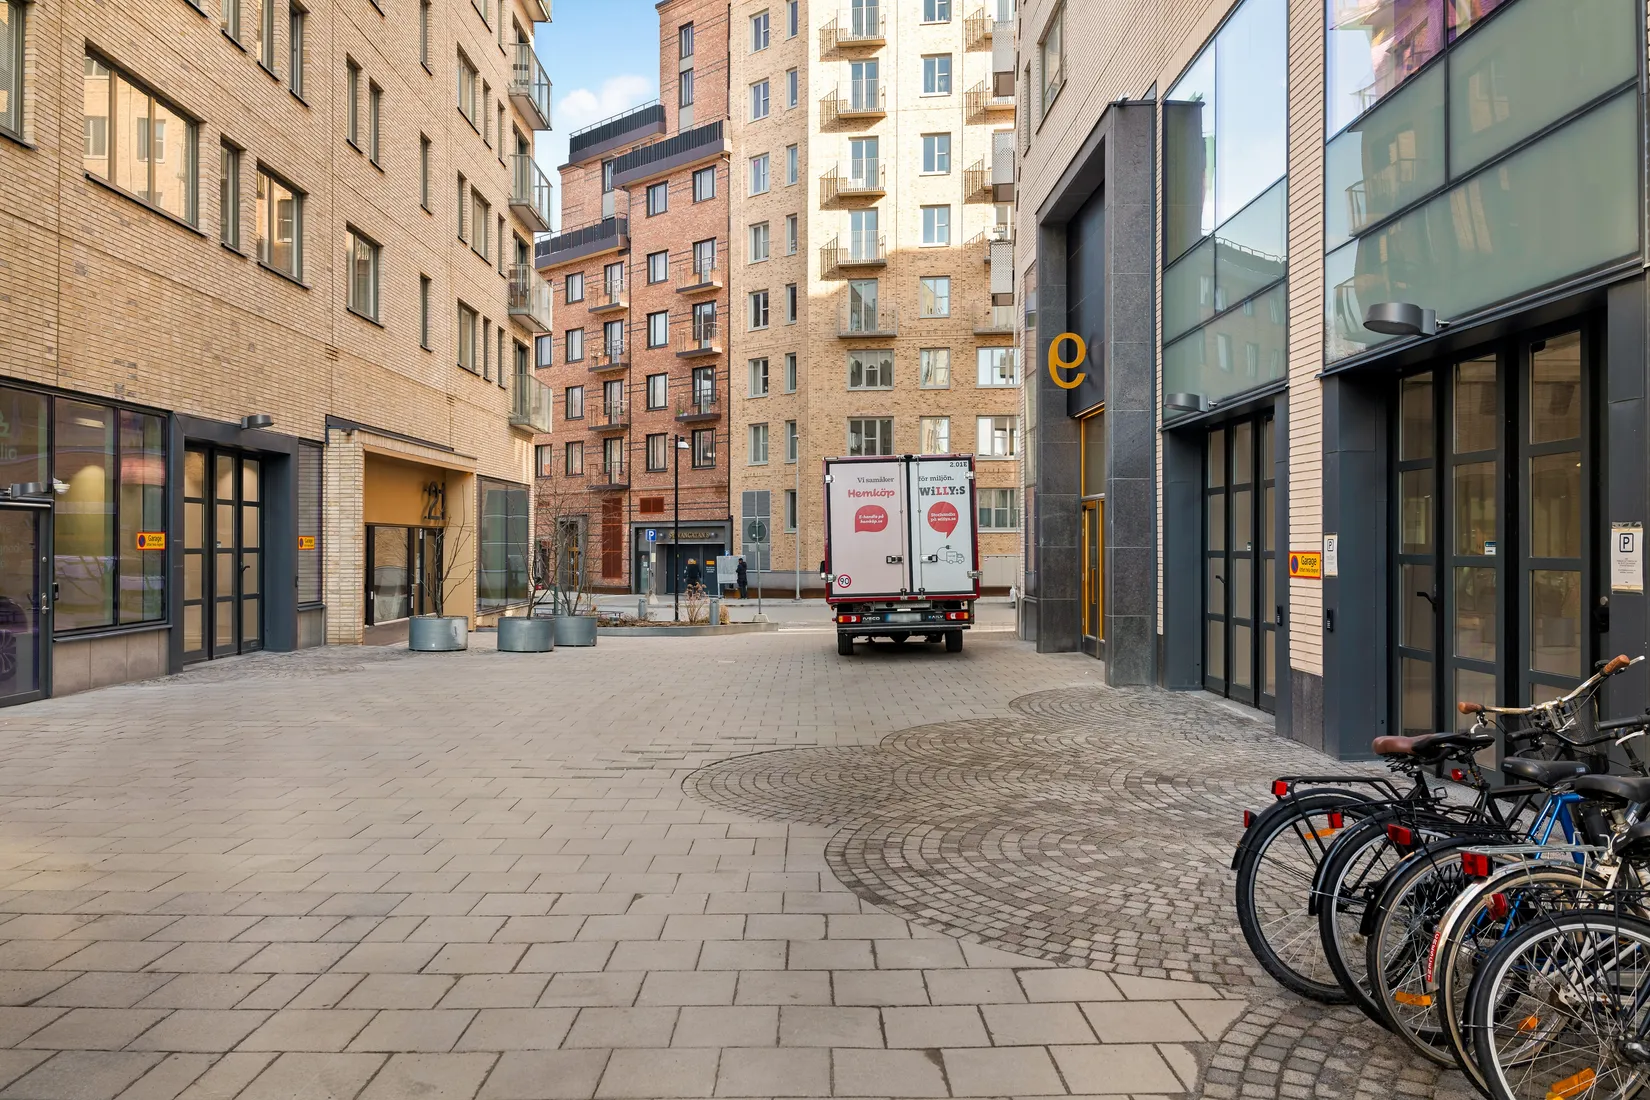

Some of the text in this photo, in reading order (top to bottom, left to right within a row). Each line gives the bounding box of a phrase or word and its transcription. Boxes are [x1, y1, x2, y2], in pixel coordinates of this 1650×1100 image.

[1047, 332, 1087, 389] e
[847, 488, 895, 498] Hemköp
[427, 481, 446, 520] 21
[147, 535, 162, 543] Garage
[1623, 536, 1630, 549] P
[1301, 555, 1317, 568] Garage
[839, 577, 850, 585] 90
[1427, 933, 1440, 981] CRESCENT
